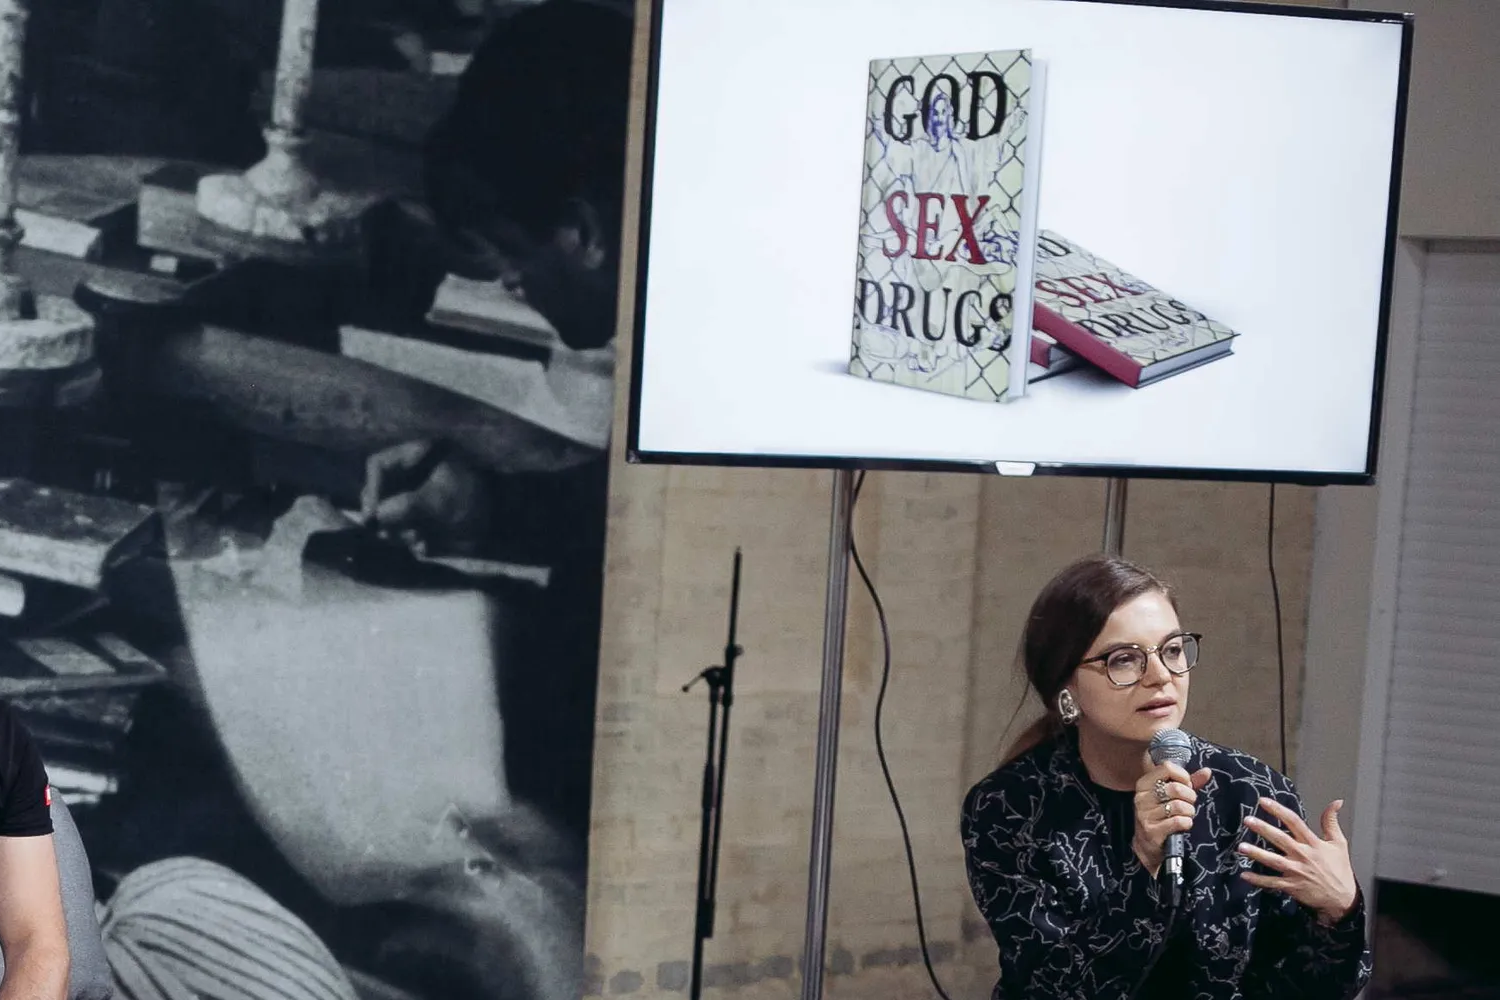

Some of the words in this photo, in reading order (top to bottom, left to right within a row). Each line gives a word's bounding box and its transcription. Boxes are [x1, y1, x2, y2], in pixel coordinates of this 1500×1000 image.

[883, 71, 1007, 143] GOD
[882, 191, 991, 264] SEX
[856, 278, 1013, 351] DRUGS
[1035, 272, 1145, 308] SEX
[1073, 299, 1204, 339] DRUGS
